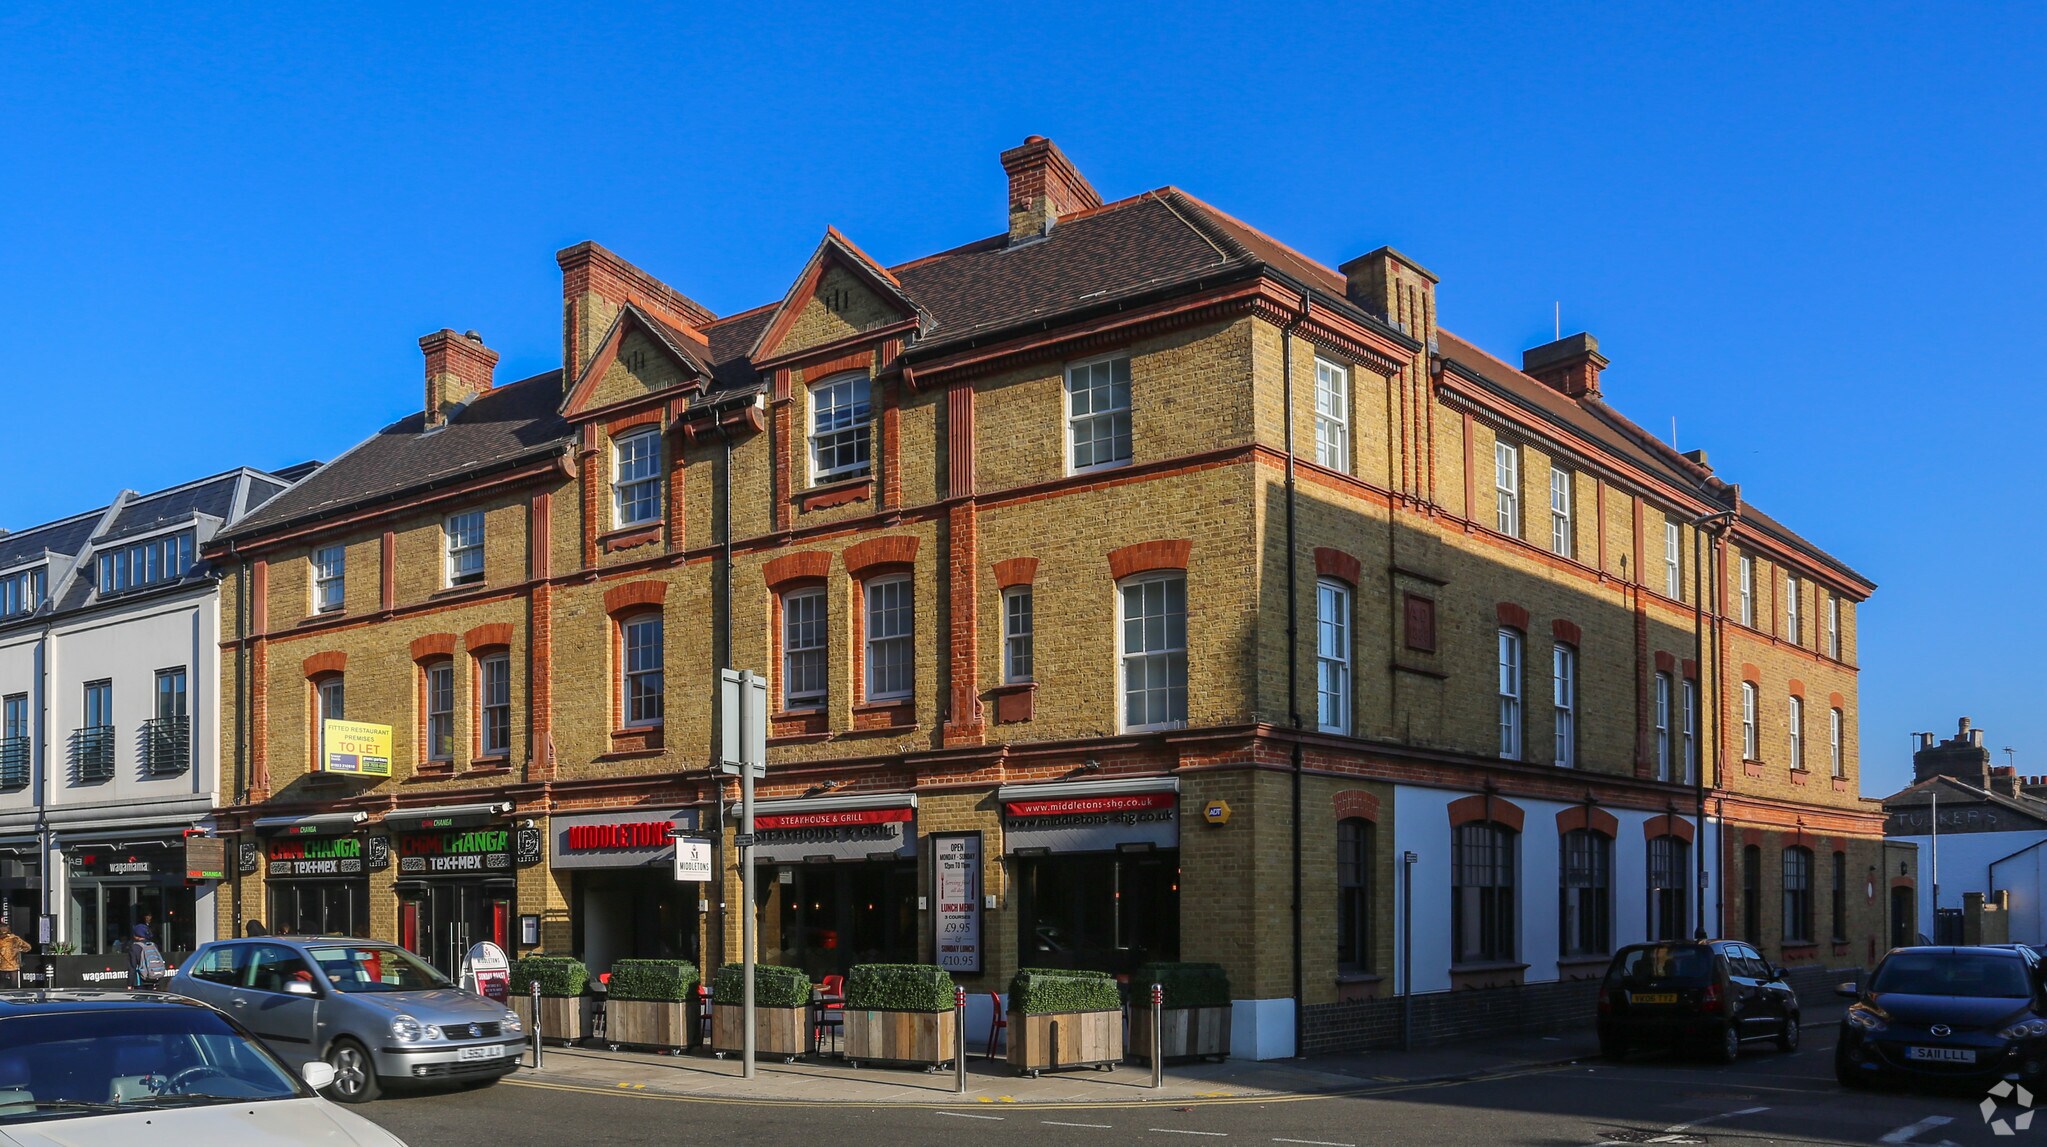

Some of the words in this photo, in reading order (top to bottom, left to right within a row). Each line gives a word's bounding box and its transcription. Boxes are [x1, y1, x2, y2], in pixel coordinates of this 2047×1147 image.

[350, 727, 390, 735] RESTAURANT
[345, 735, 375, 743] PREMISES
[338, 741, 355, 752] TO
[359, 744, 380, 755] LET
[1025, 797, 1153, 812] www.middletons-shg.co.uk
[1209, 808, 1221, 816] ADT
[781, 815, 830, 825] STEAKHOUSE
[833, 814, 838, 822] &
[841, 813, 863, 822] GRILL
[568, 821, 675, 849] MIDDLETONS
[754, 826, 840, 841] STEAKHOUSE
[861, 824, 899, 837] GRILL
[950, 843, 964, 852] OPEN
[109, 862, 149, 875] wagamama
[680, 862, 709, 871] MIDDLETONS
[941, 903, 958, 912] LUNCH
[959, 903, 975, 912] MENU
[944, 923, 971, 933] £9.95
[941, 945, 959, 953] SUNDAY
[960, 945, 975, 953] LUNCH
[942, 955, 973, 966] £10.95
[1944, 1049, 1968, 1060] LLL
